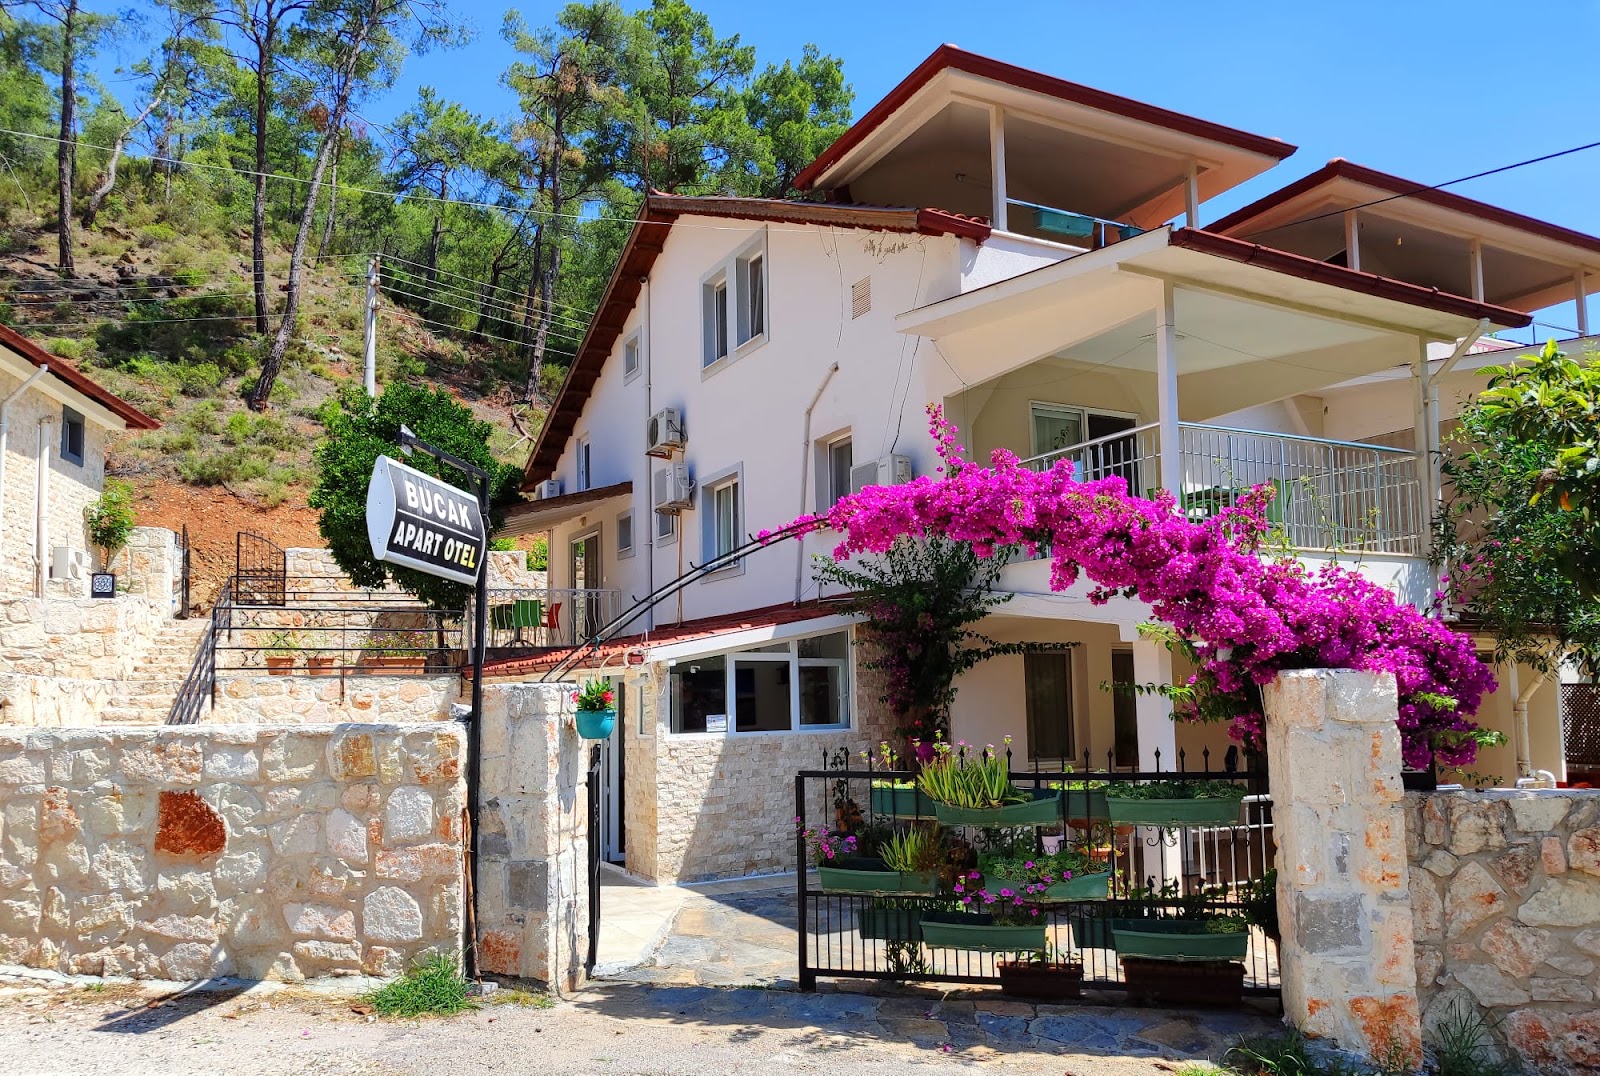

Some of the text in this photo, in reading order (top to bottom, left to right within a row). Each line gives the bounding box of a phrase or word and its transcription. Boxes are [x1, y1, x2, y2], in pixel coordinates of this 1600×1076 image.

[404, 480, 473, 530] BUCAK
[393, 520, 475, 569] APART OTEL
